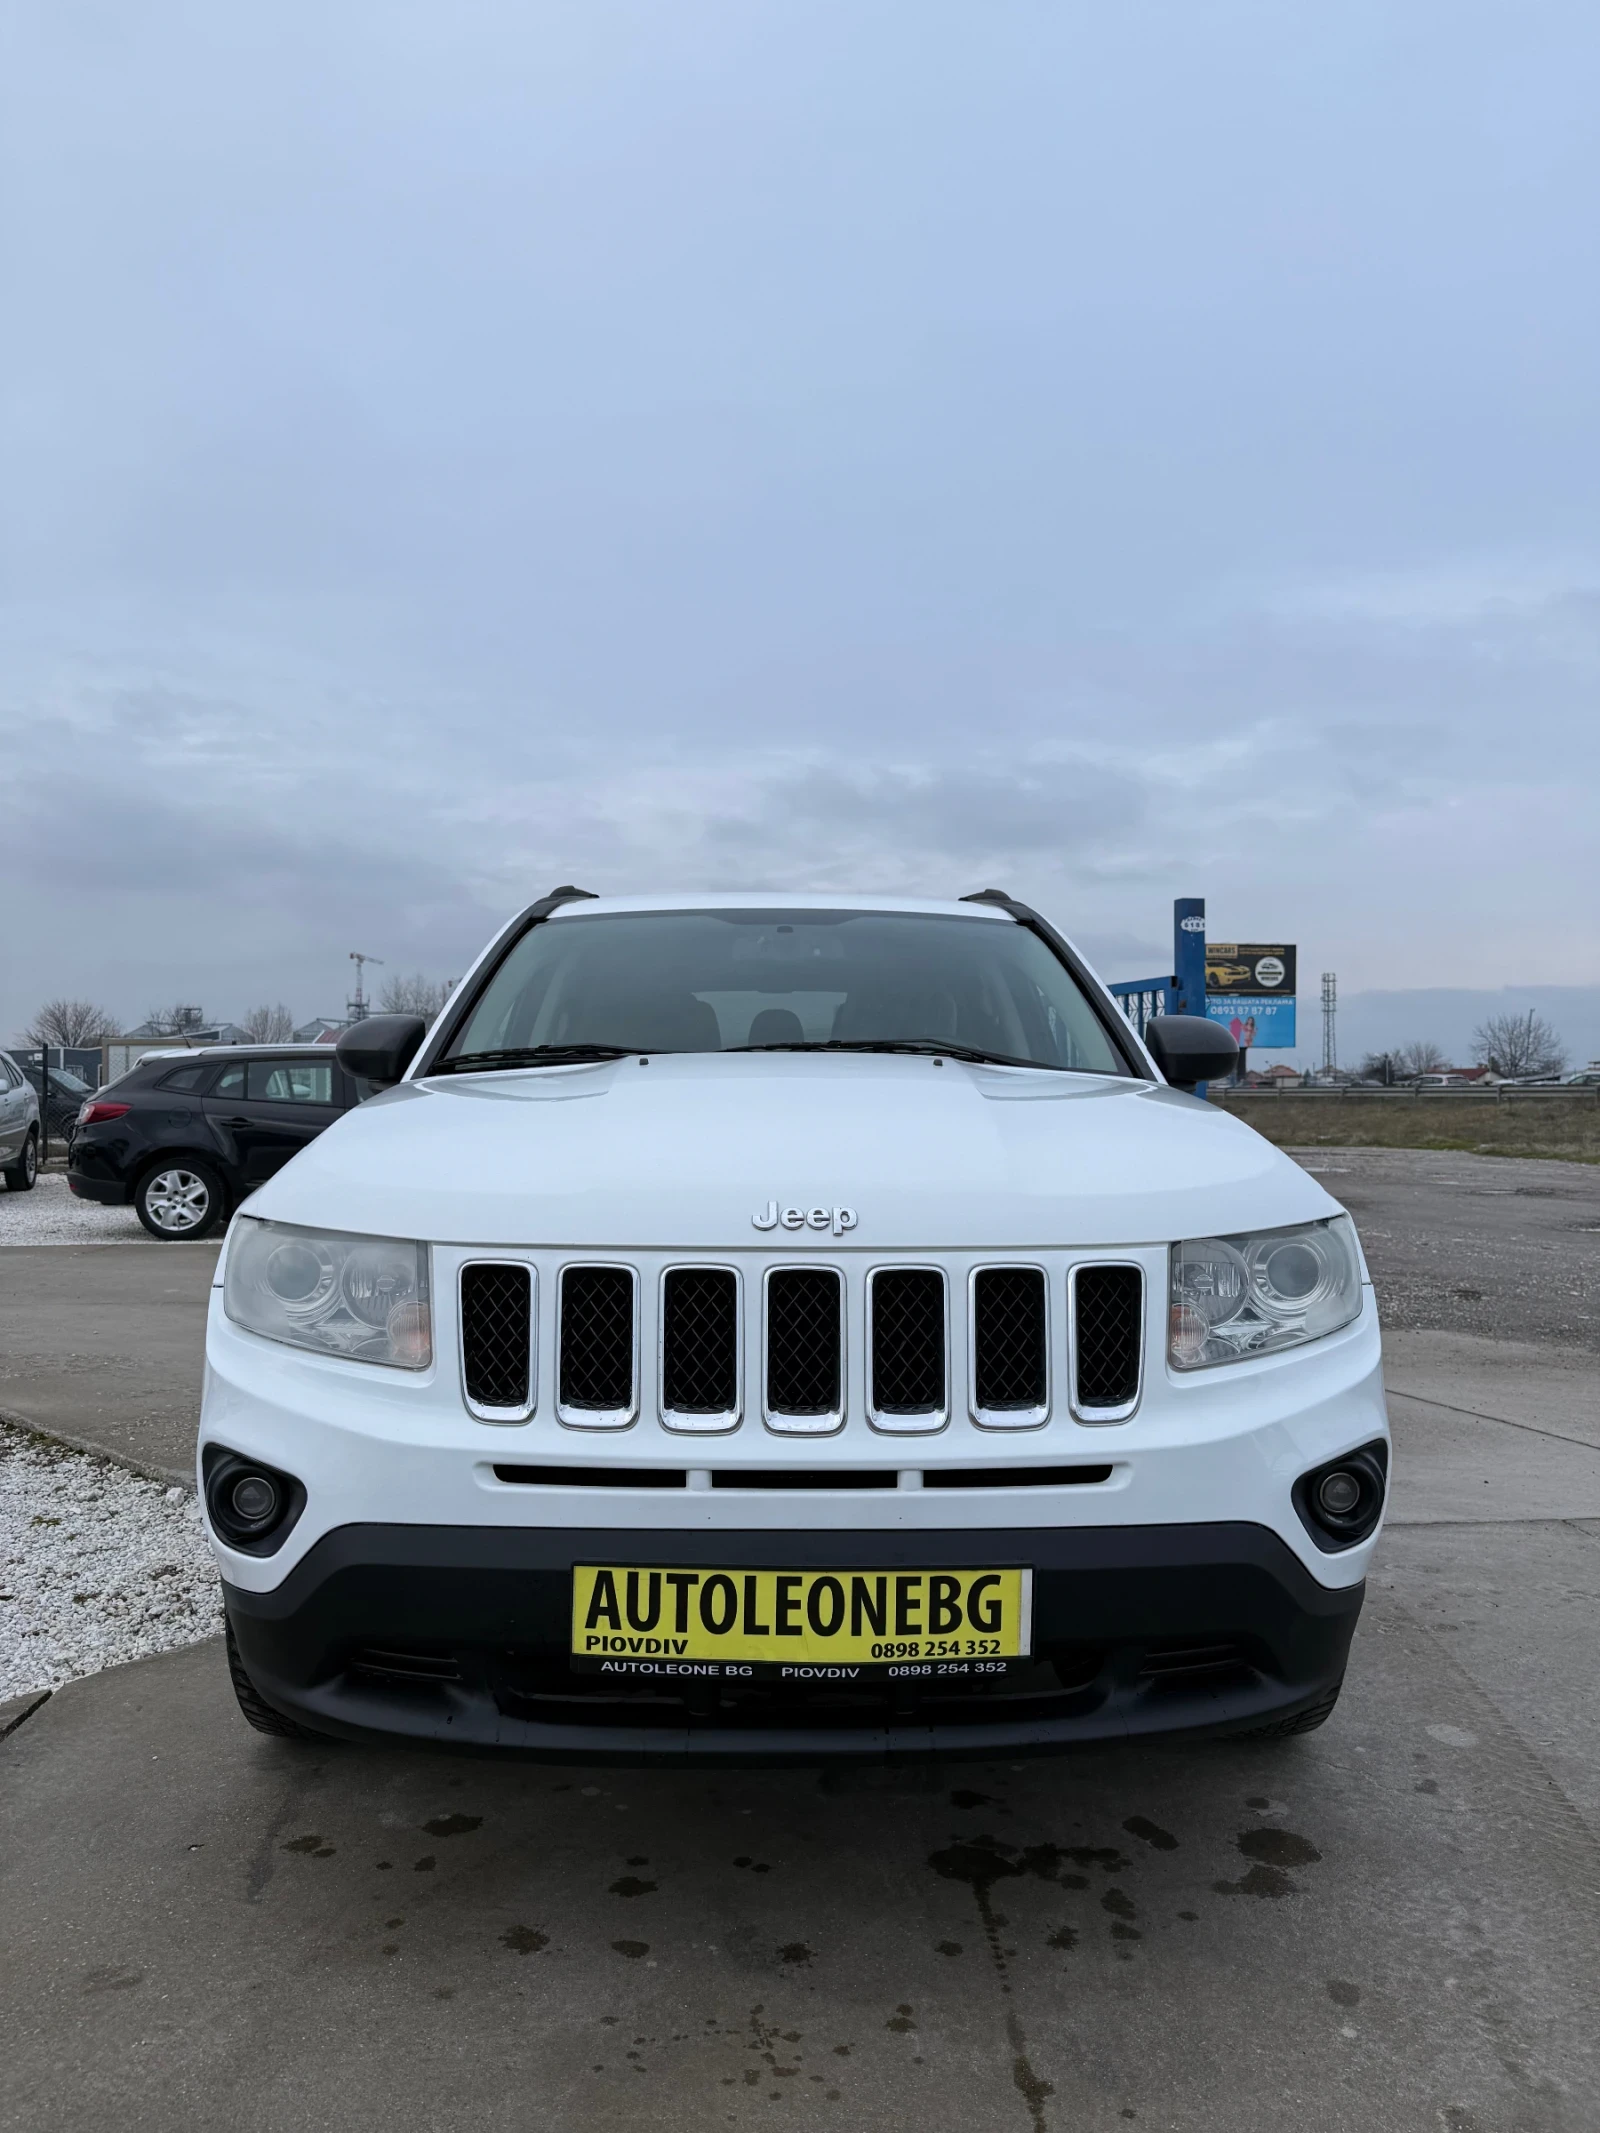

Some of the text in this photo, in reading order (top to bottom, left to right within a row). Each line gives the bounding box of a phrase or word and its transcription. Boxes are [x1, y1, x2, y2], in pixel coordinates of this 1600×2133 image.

[1207, 946, 1236, 954] WINCARS
[1210, 1006, 1235, 1015] 0893
[1237, 1006, 1249, 1015] 87
[1265, 1006, 1277, 1015] 87
[751, 1200, 858, 1237] Jeep
[585, 1570, 1002, 1637] AUTOLEONEBG
[586, 1635, 689, 1654] PIOVDIV
[871, 1639, 1001, 1658] 0898 254 352
[601, 1661, 1007, 1678] AUTOLEONE BG PIOVDIV 0898 254 352
